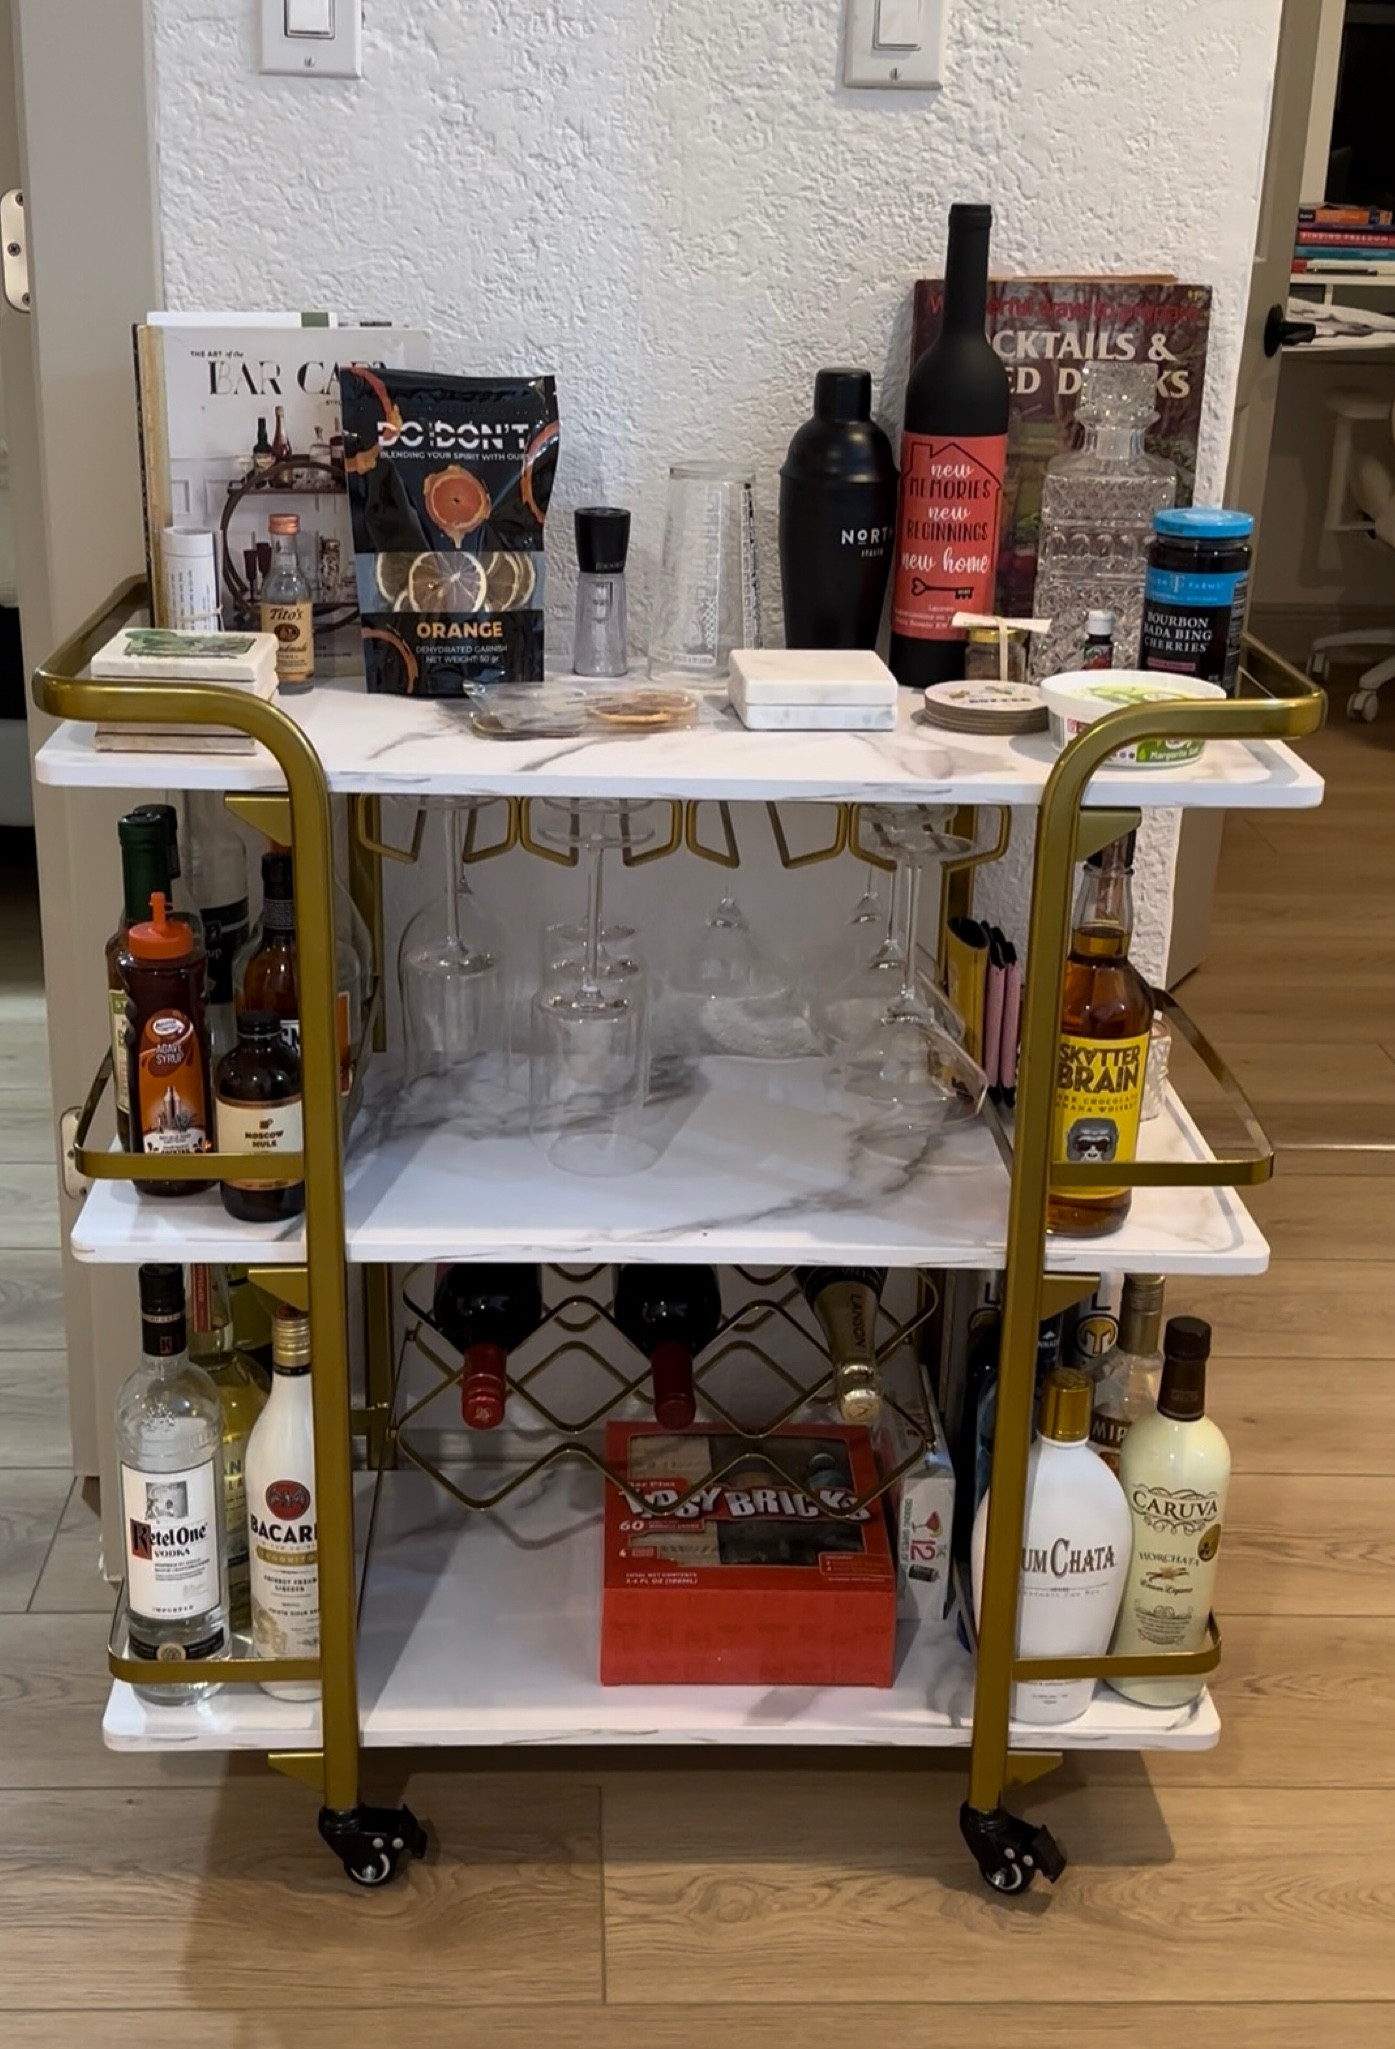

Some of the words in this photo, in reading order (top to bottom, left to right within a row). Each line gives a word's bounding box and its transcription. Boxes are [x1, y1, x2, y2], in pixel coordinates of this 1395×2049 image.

[986, 330, 1137, 361] CKTAILS
[1148, 333, 1177, 361] &
[207, 360, 282, 395] BAR
[380, 451, 426, 459] BLENDING
[428, 451, 450, 459] YOUR
[453, 452, 480, 460] SPIRIT
[482, 453, 505, 461] WITH
[931, 463, 975, 480] new
[909, 476, 992, 499] MEMORIES
[928, 506, 971, 522] new
[907, 519, 988, 542] BEGINNINGS
[901, 552, 937, 572] new
[942, 546, 989, 574] home
[270, 607, 304, 621] Tito's
[1147, 611, 1210, 629] BOURBON
[416, 621, 504, 639] ORANGE
[1175, 629, 1213, 641] BING
[416, 646, 473, 654] DEHYDRATED
[1145, 636, 1207, 653] CHERRIES
[426, 655, 442, 663] NET
[480, 655, 490, 663] 50
[156, 1044, 183, 1054] AGAVE
[156, 1054, 184, 1066] SYRUP
[1059, 1062, 1139, 1093] BRAIN
[1058, 1094, 1077, 1102] ARK
[245, 1130, 284, 1139] MOSCOW
[252, 1140, 277, 1148] MULE
[851, 1294, 867, 1349] LANSON
[1133, 1490, 1218, 1520] CARUVA
[619, 1521, 645, 1531] 60
[154, 1548, 190, 1558] VODKA
[910, 1540, 936, 1560] 12
[1139, 1551, 1199, 1567] HORCHATA
[152, 1605, 194, 1614] IMPORTED
